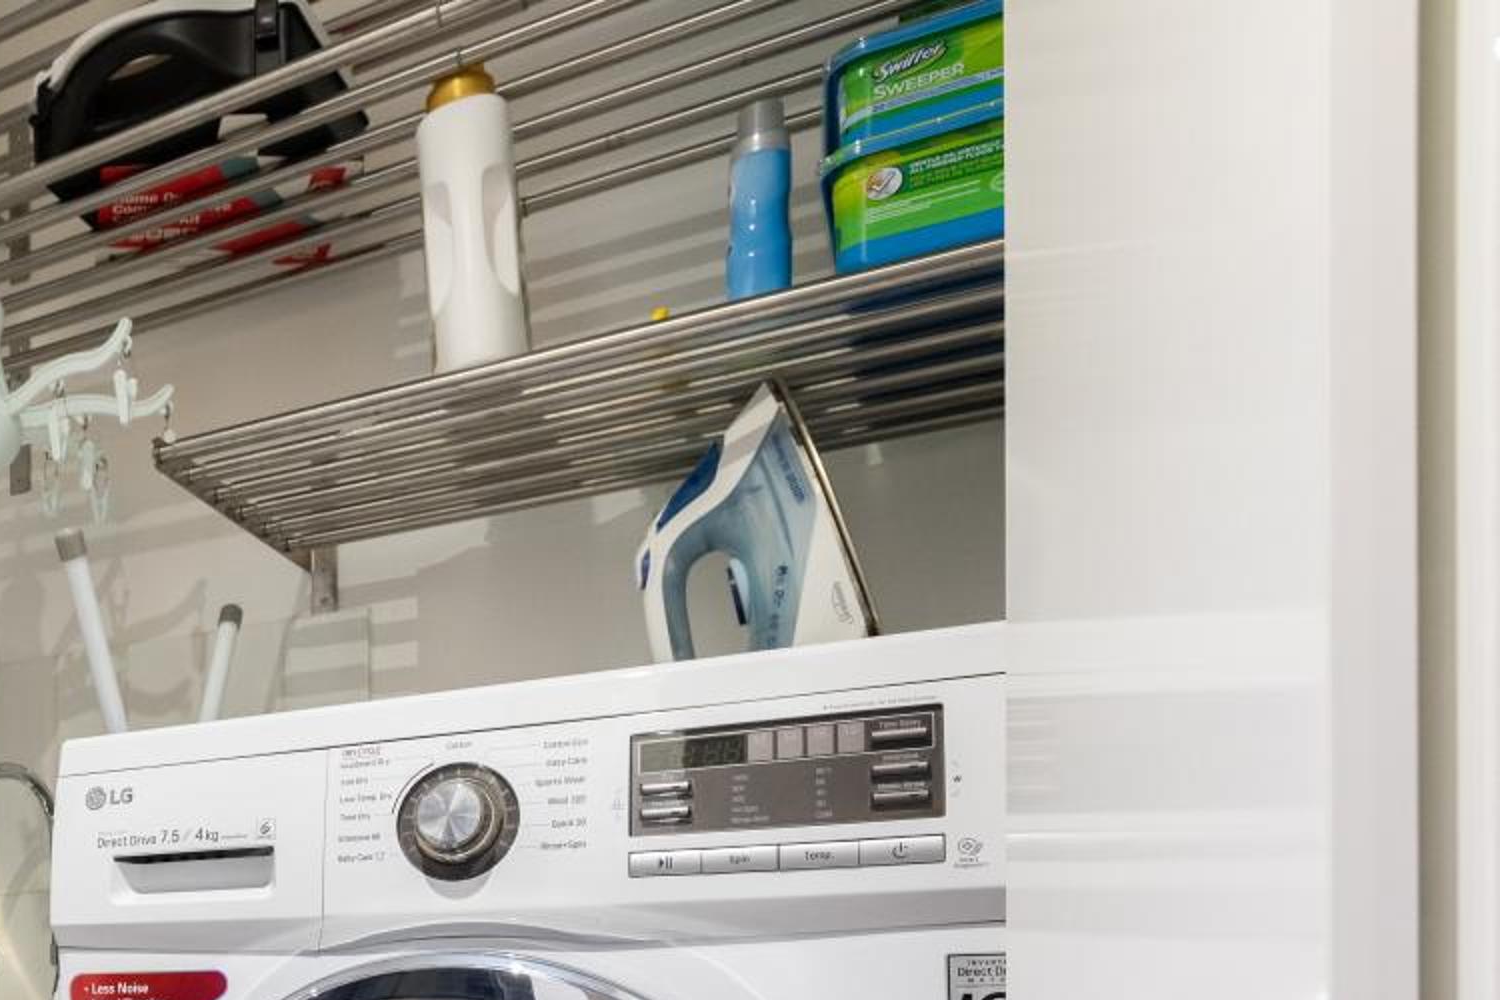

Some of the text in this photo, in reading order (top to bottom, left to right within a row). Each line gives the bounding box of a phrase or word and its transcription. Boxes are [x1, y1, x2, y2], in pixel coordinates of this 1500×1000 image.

[874, 62, 964, 99] SWEEPER
[109, 787, 133, 805] LG
[97, 836, 127, 848] Direct
[129, 834, 157, 846] Drive
[160, 828, 180, 844] 7.5
[91, 982, 149, 995] Less Noise
